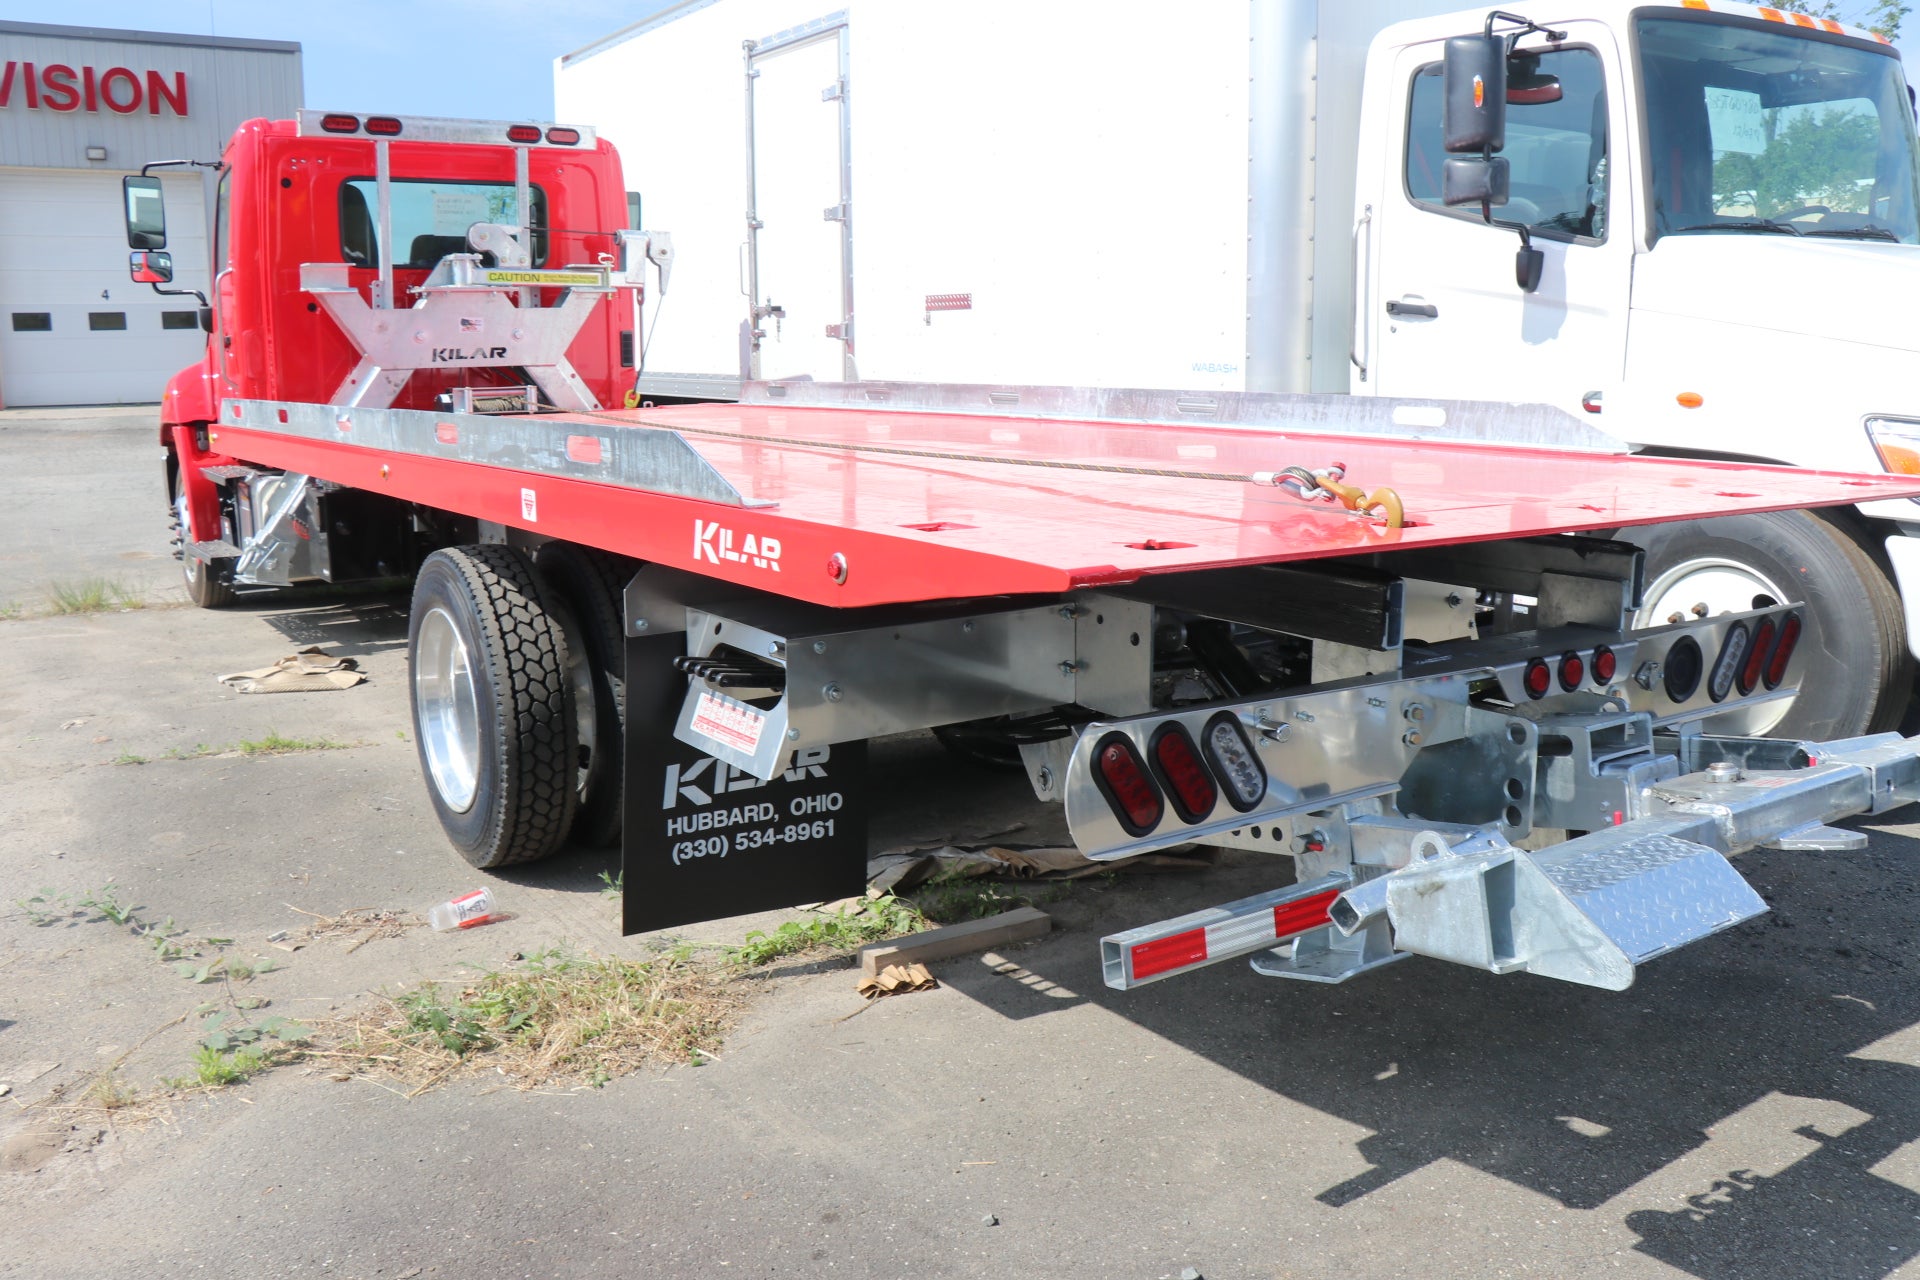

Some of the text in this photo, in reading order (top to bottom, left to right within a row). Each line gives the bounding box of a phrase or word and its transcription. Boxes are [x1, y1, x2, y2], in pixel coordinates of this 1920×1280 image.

[488, 272, 541, 282] CAUTION
[101, 289, 110, 301] 4
[432, 347, 507, 362] KILAR
[1192, 362, 1238, 373] WABASH
[693, 519, 781, 572] KILAR
[667, 792, 843, 837] HUBBARD, OHIO
[672, 819, 835, 866] (330) 534-8961
